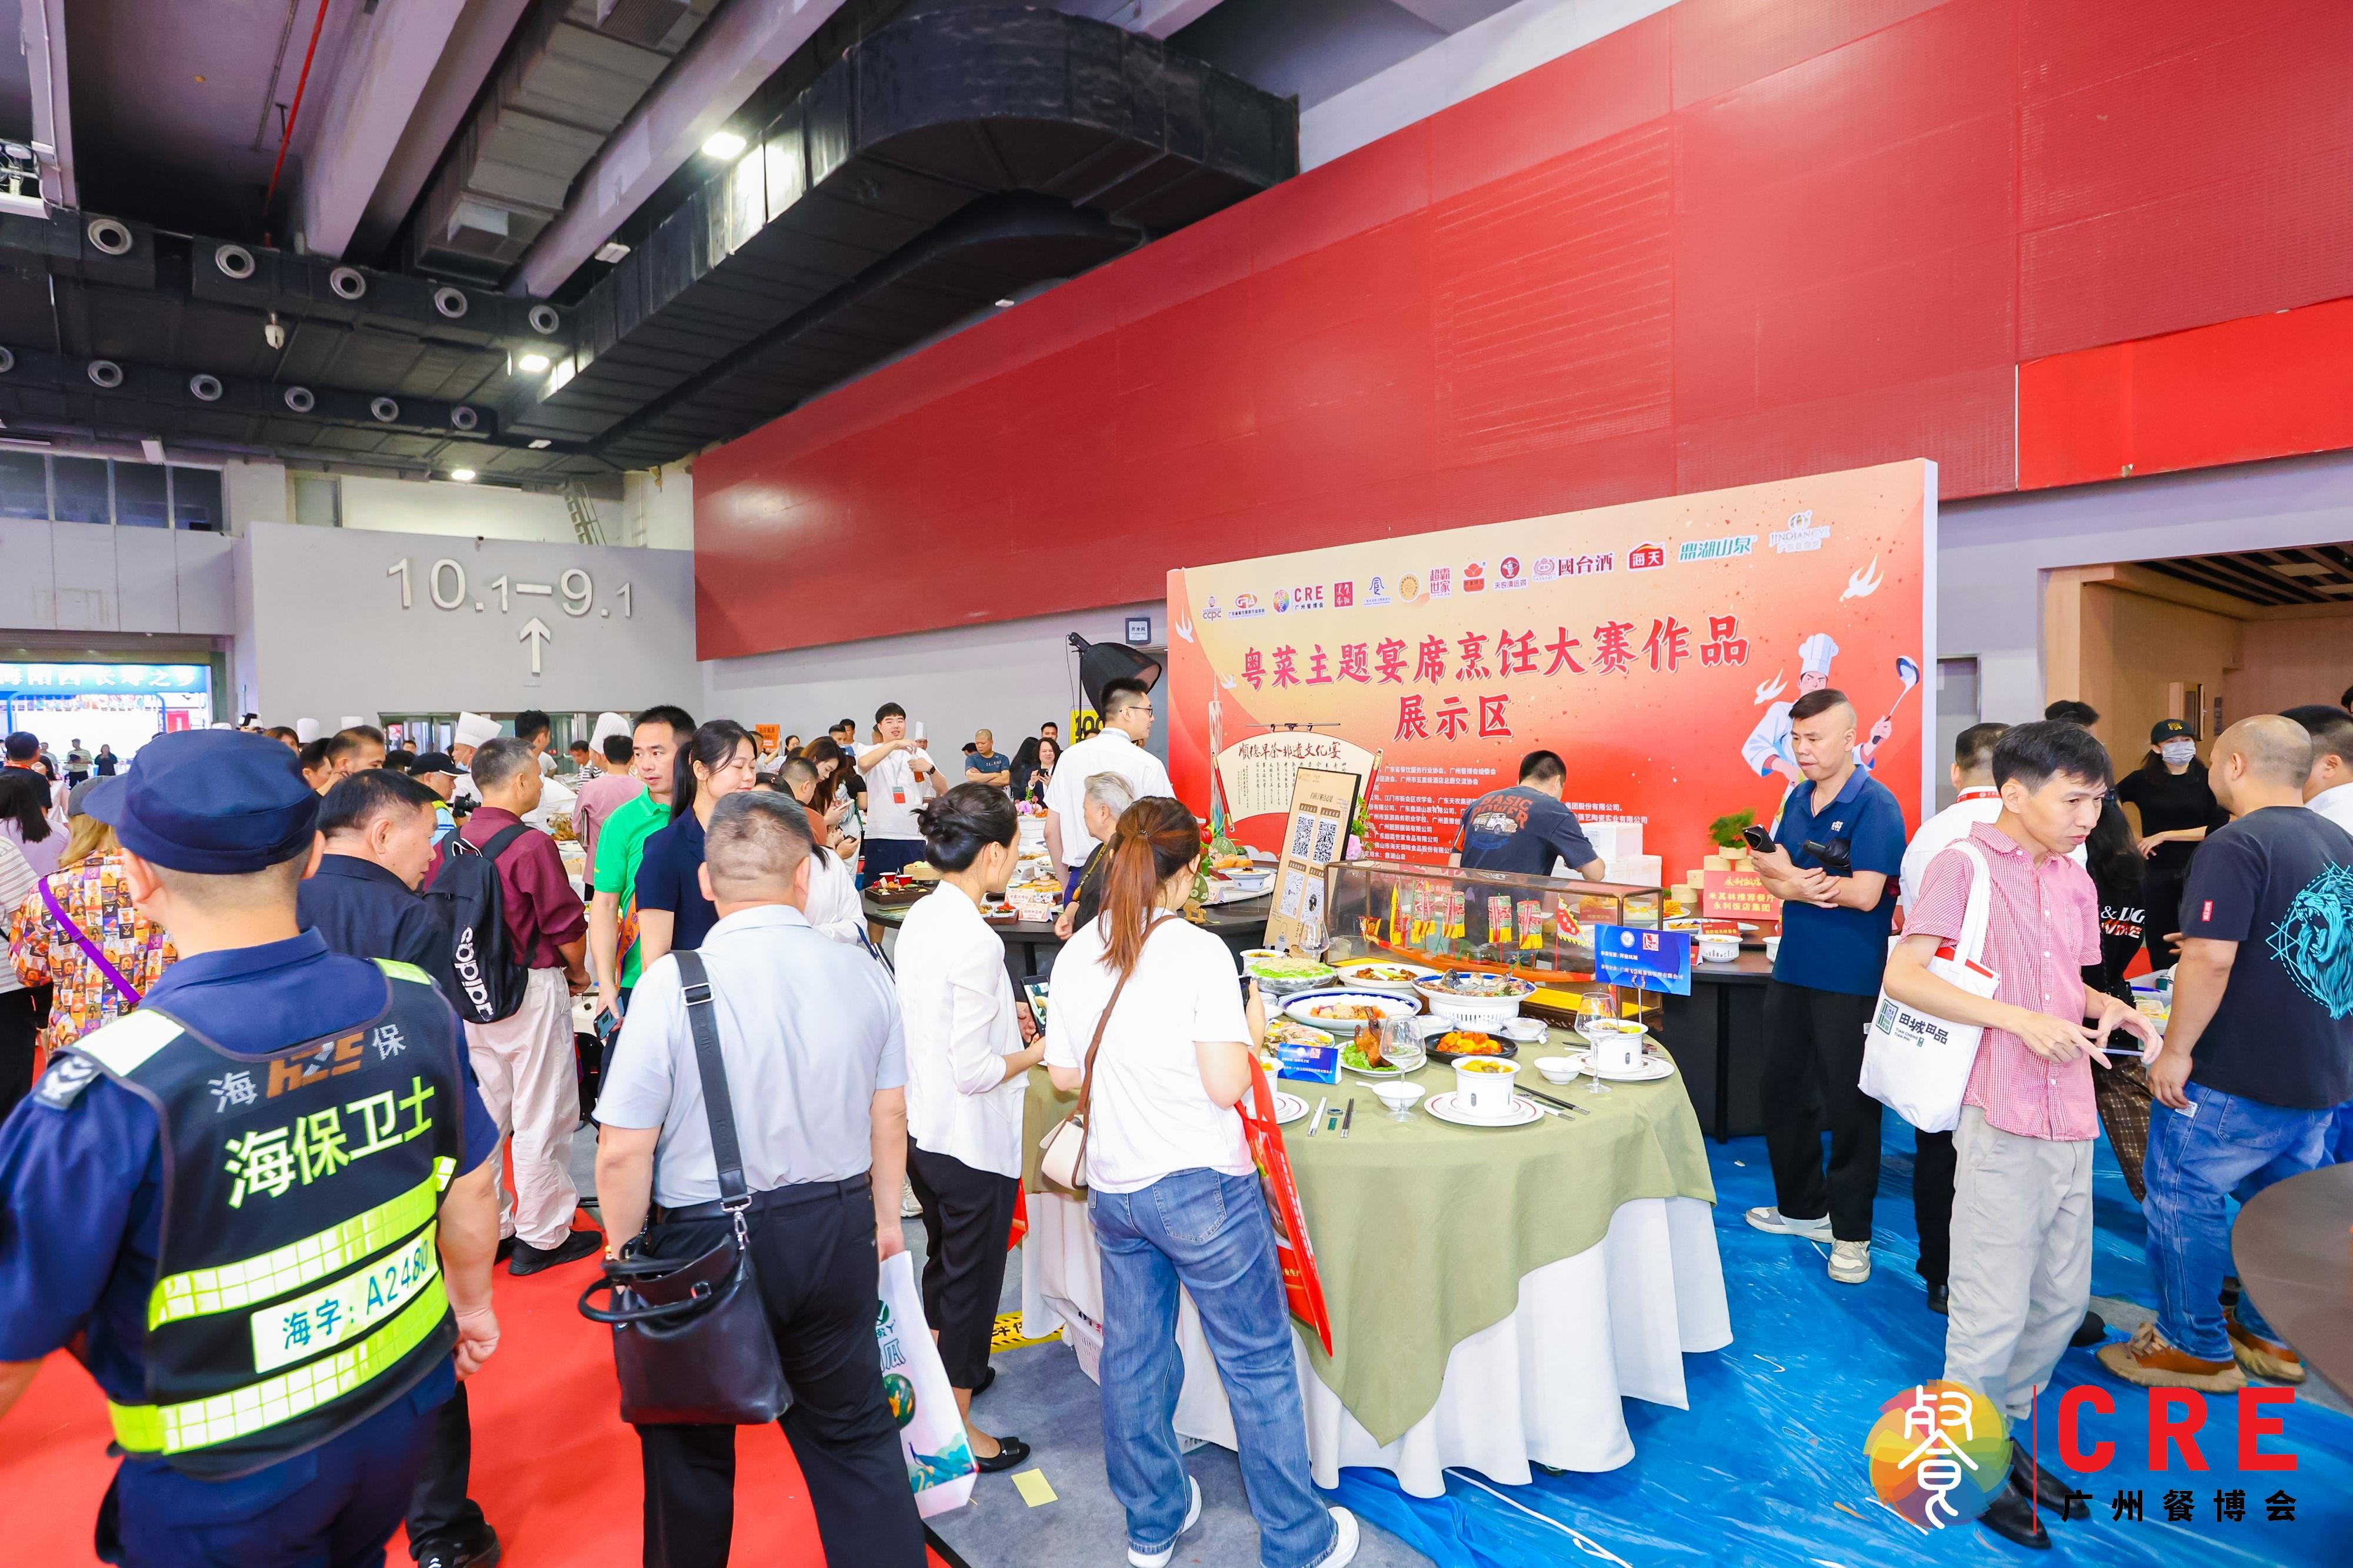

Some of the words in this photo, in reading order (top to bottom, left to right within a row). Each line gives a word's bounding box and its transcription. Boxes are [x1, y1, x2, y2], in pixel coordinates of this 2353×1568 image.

[1680, 536, 1751, 560] 鼎湖山泉
[1558, 553, 1613, 576] 國台酒
[1632, 550, 1662, 566] 海天
[1430, 568, 1450, 581] 超霸
[1294, 586, 1324, 602] CRE
[1430, 581, 1450, 594] 世家
[1295, 602, 1324, 610] 广州餐博会
[1241, 615, 1751, 691] 粤菜主题宴席烹饪大赛作品
[1394, 693, 1512, 741] 展示区
[1479, 795, 1533, 811] BASIC
[1708, 892, 1775, 902] 米其林推荐餐厅
[1713, 901, 1771, 912] 永利饭店集团
[2100, 906, 2117, 919] &
[454, 926, 494, 1022] adidas
[1898, 1012, 1949, 1045] 田城田品
[1905, 1031, 1918, 1040] CHENG
[207, 1069, 258, 1113] 海
[372, 1023, 407, 1061] 保
[224, 1075, 435, 1209] 海保卫士
